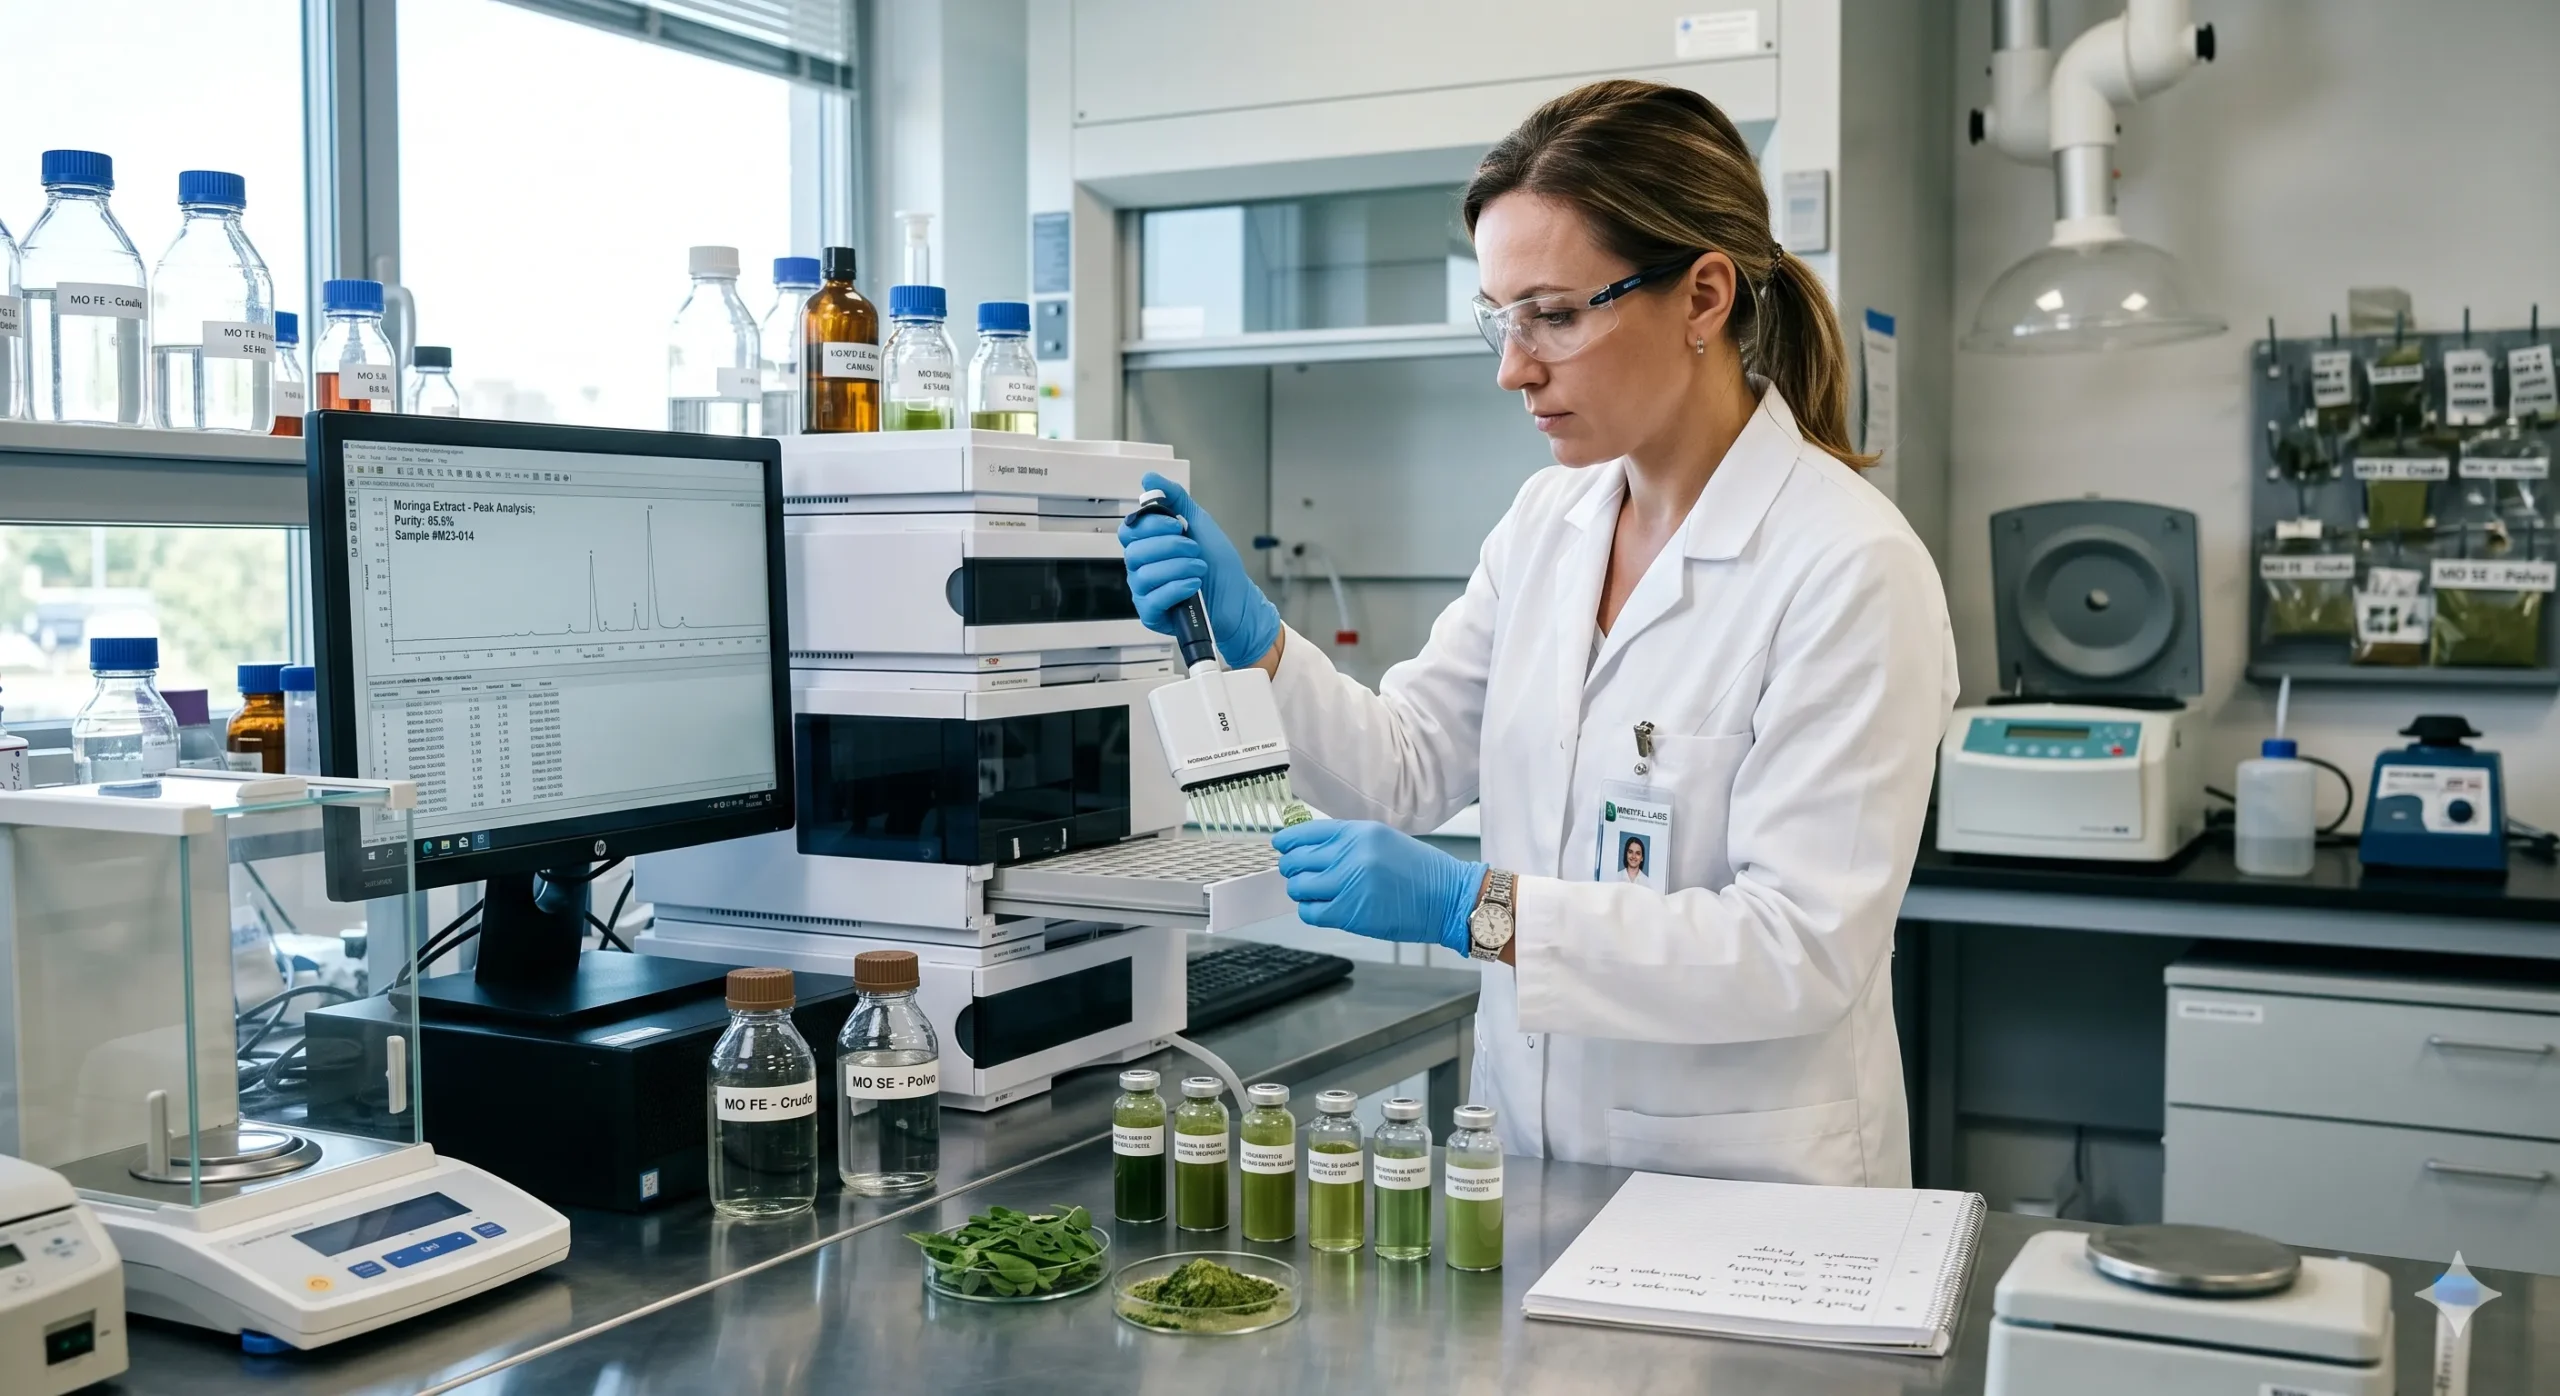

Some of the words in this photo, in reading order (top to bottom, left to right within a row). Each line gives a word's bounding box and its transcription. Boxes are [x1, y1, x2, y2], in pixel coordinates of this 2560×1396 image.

[71, 295, 90, 305] MO
[94, 296, 105, 306] FE
[224, 328, 242, 338] MO
[245, 330, 255, 339] TE
[357, 372, 374, 380] MO
[393, 499, 431, 513] Moringa
[433, 500, 466, 512] Extract
[473, 501, 495, 513] Peak
[394, 514, 425, 527] Purity:
[395, 529, 430, 543] Sample
[431, 530, 475, 541] #M23-014
[853, 1076, 873, 1089] MO
[876, 1077, 895, 1089] SE
[908, 1074, 936, 1088] Polvo
[724, 1098, 746, 1111] MO
[750, 1099, 768, 1111] FE
